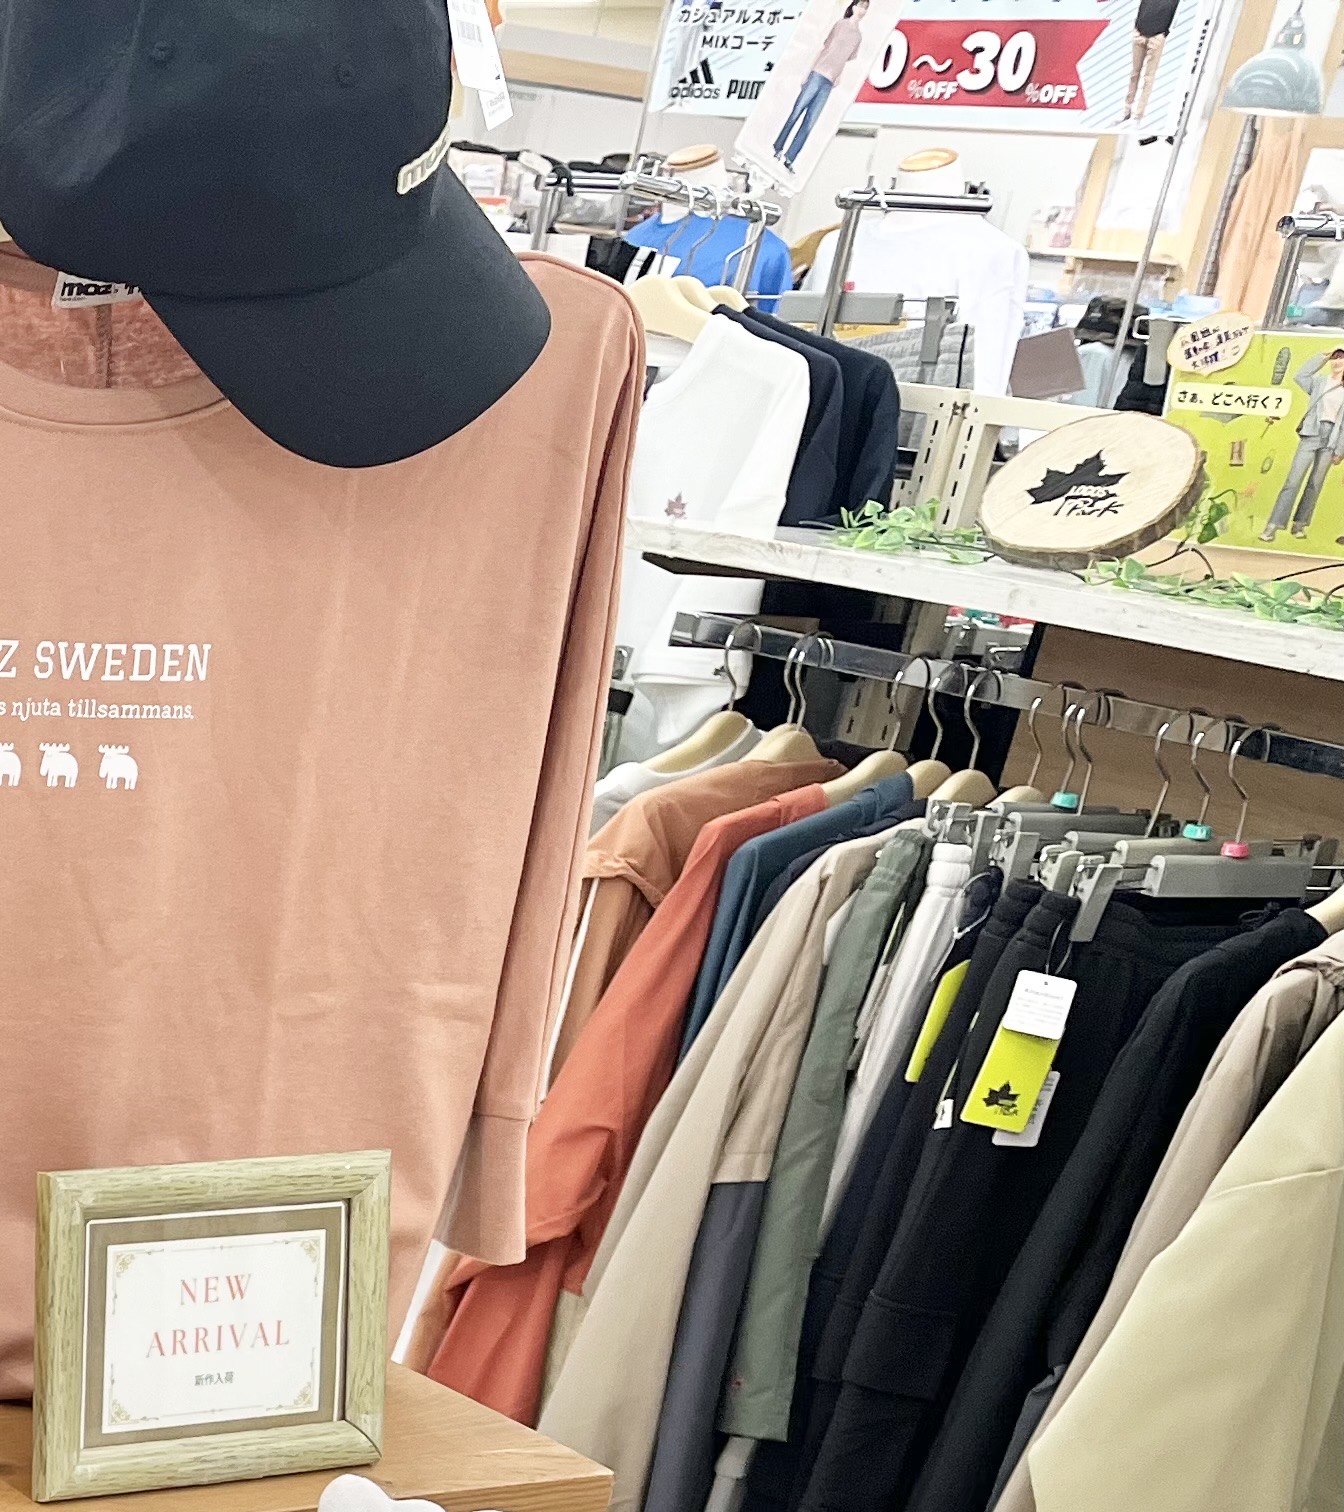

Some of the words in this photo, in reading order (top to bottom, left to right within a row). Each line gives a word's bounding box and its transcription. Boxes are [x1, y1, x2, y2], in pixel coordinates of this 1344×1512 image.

[670, 83, 721, 100] adidas
[61, 281, 112, 297] moz
[33, 640, 212, 682] SWEDEN
[11, 697, 62, 722] njuta
[179, 1272, 253, 1306] NEW
[146, 1319, 290, 1358] ARRIVAL
